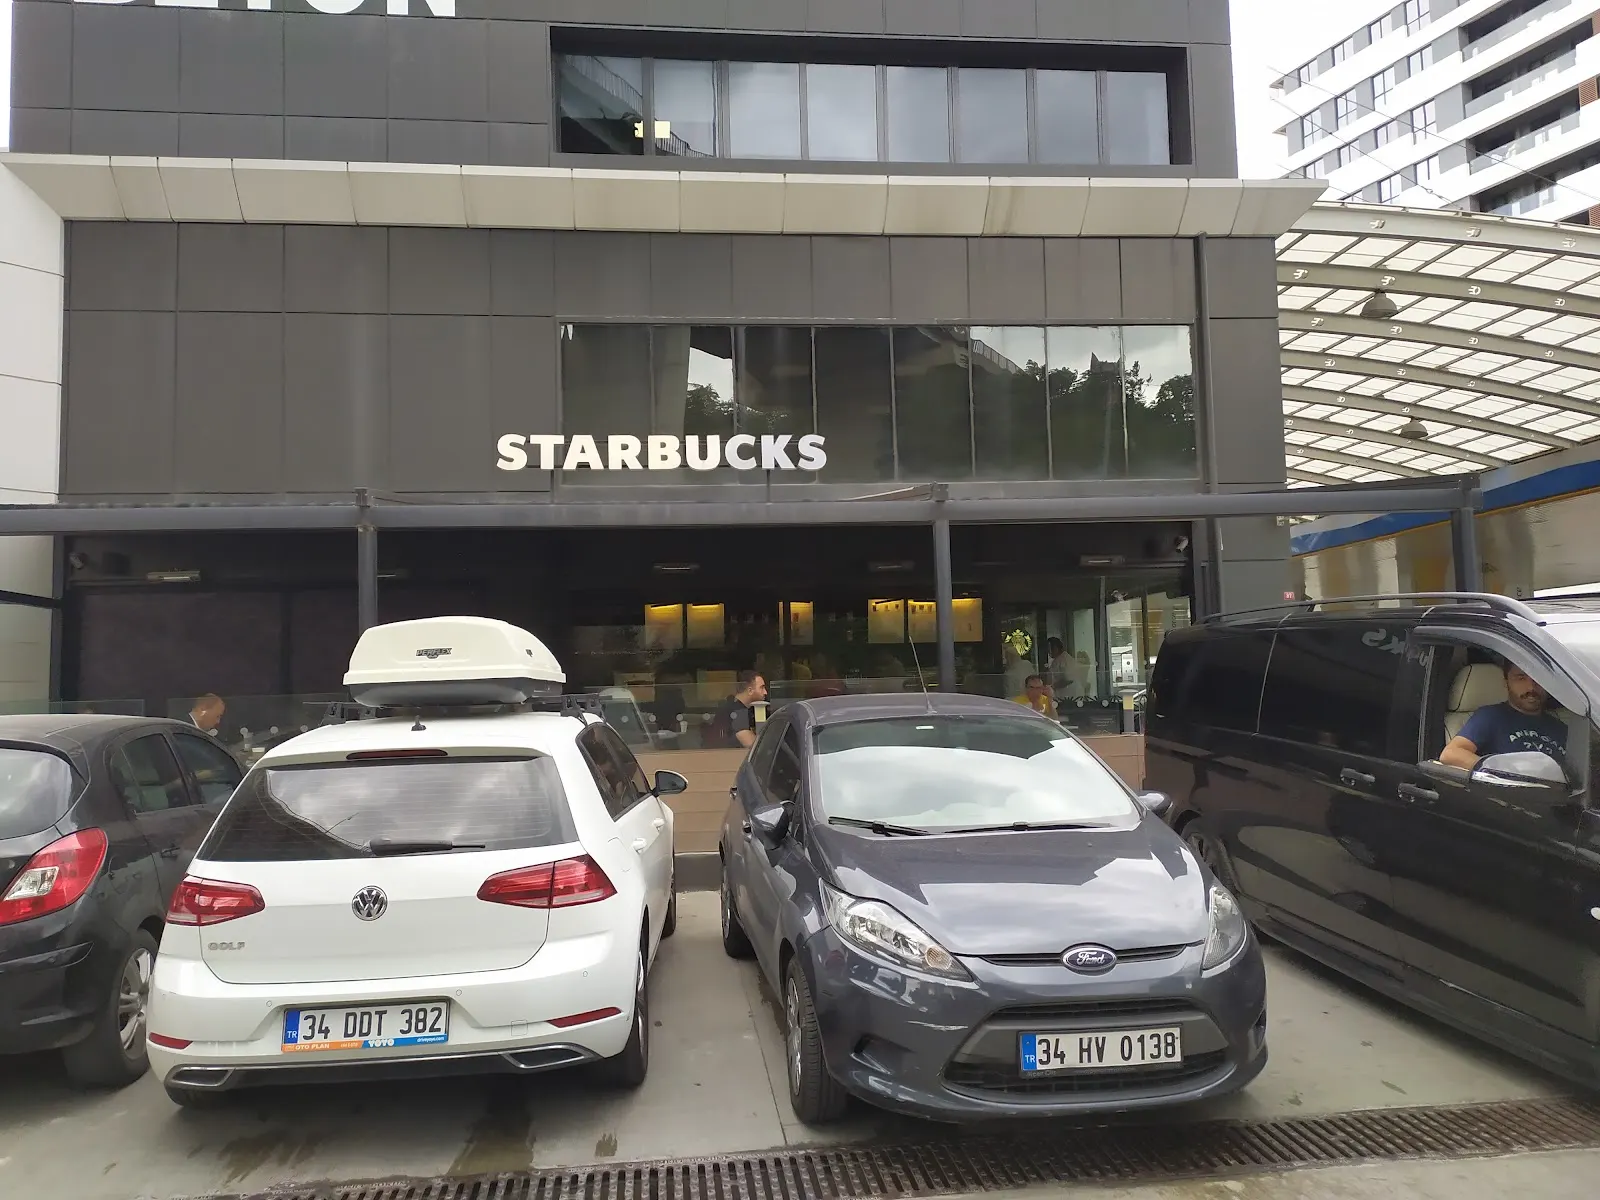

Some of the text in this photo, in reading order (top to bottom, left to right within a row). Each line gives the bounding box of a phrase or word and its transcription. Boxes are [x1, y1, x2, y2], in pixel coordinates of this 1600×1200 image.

[496, 433, 827, 471] STARBUCKS
[208, 941, 245, 951] GOLF
[1077, 951, 1105, 965] Ford
[287, 1007, 443, 1041] TR 34 DDT 382
[368, 1039, 394, 1048] YOYO
[1025, 1032, 1176, 1065] TR 34 HV 0138
